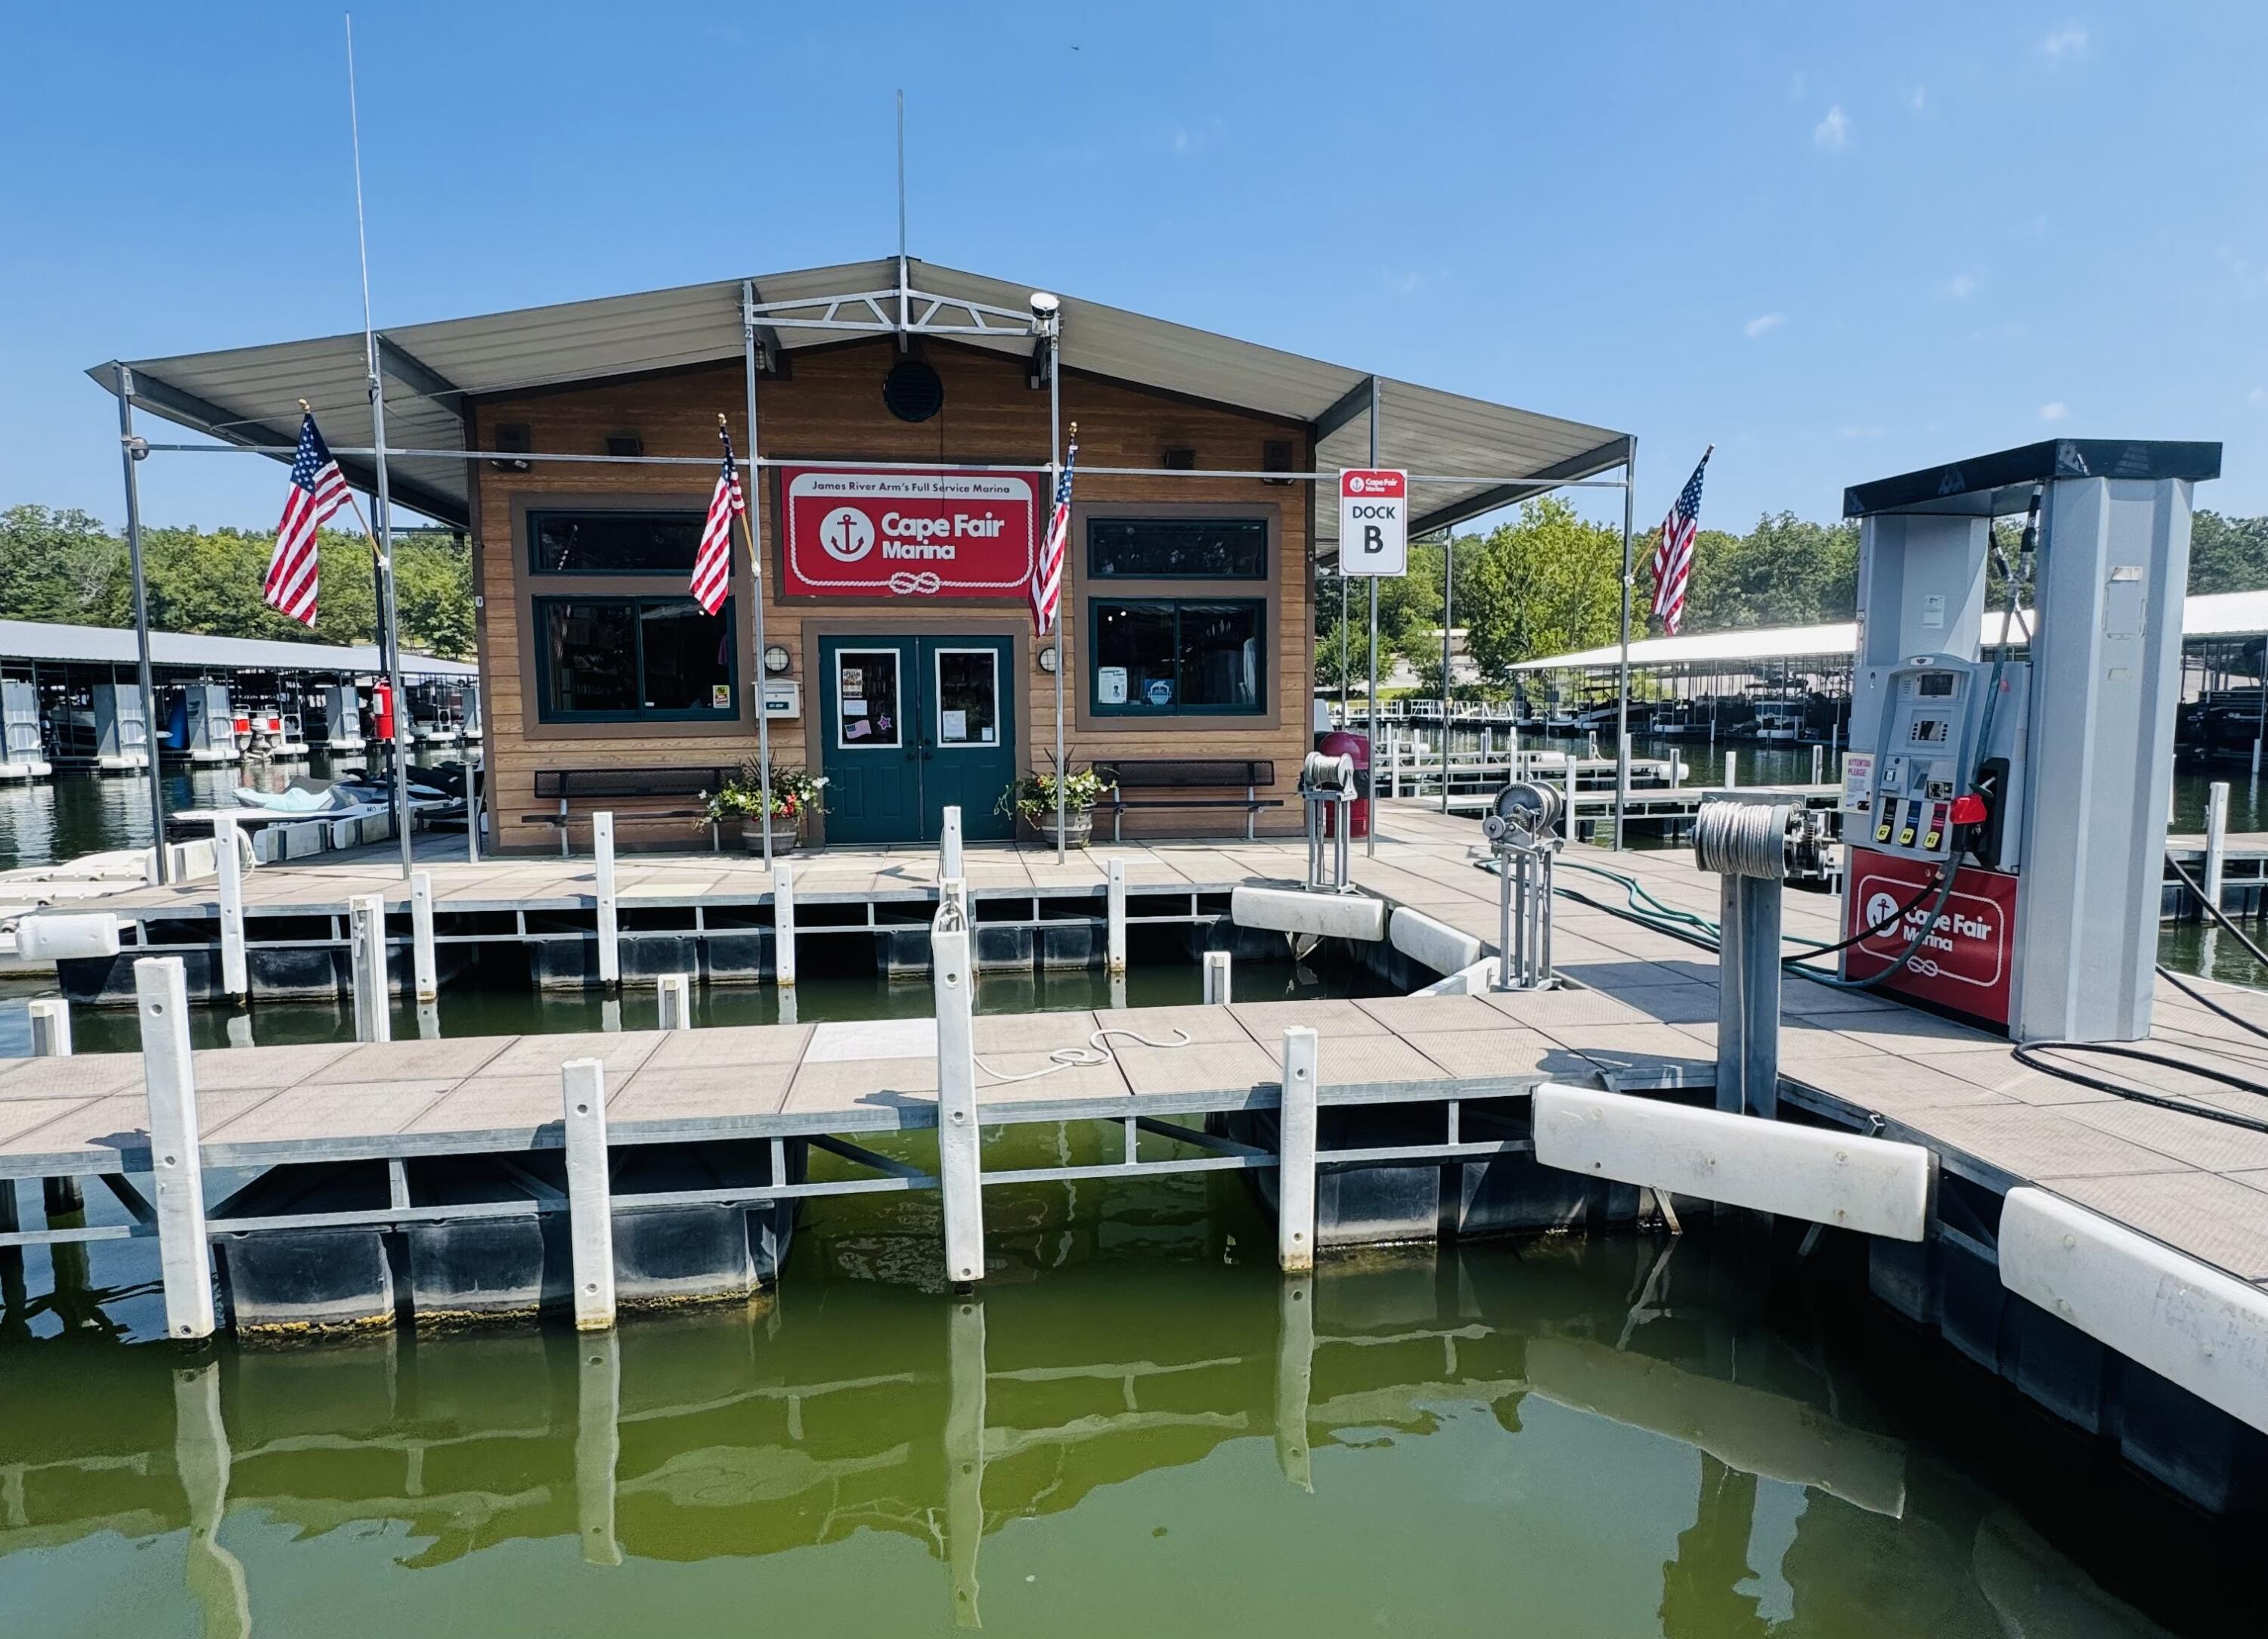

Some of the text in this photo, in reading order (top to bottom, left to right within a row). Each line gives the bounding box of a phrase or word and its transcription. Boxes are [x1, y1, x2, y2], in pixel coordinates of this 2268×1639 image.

[812, 481, 1010, 494] James River Arm's Full Service Marina
[1365, 478, 1398, 488] Cape Fair
[1352, 506, 1396, 519] DOCK
[881, 512, 1005, 542] Cape Fair
[882, 539, 956, 559] Marina
[1364, 525, 1383, 554] B
[1954, 912, 1992, 940] Fair
